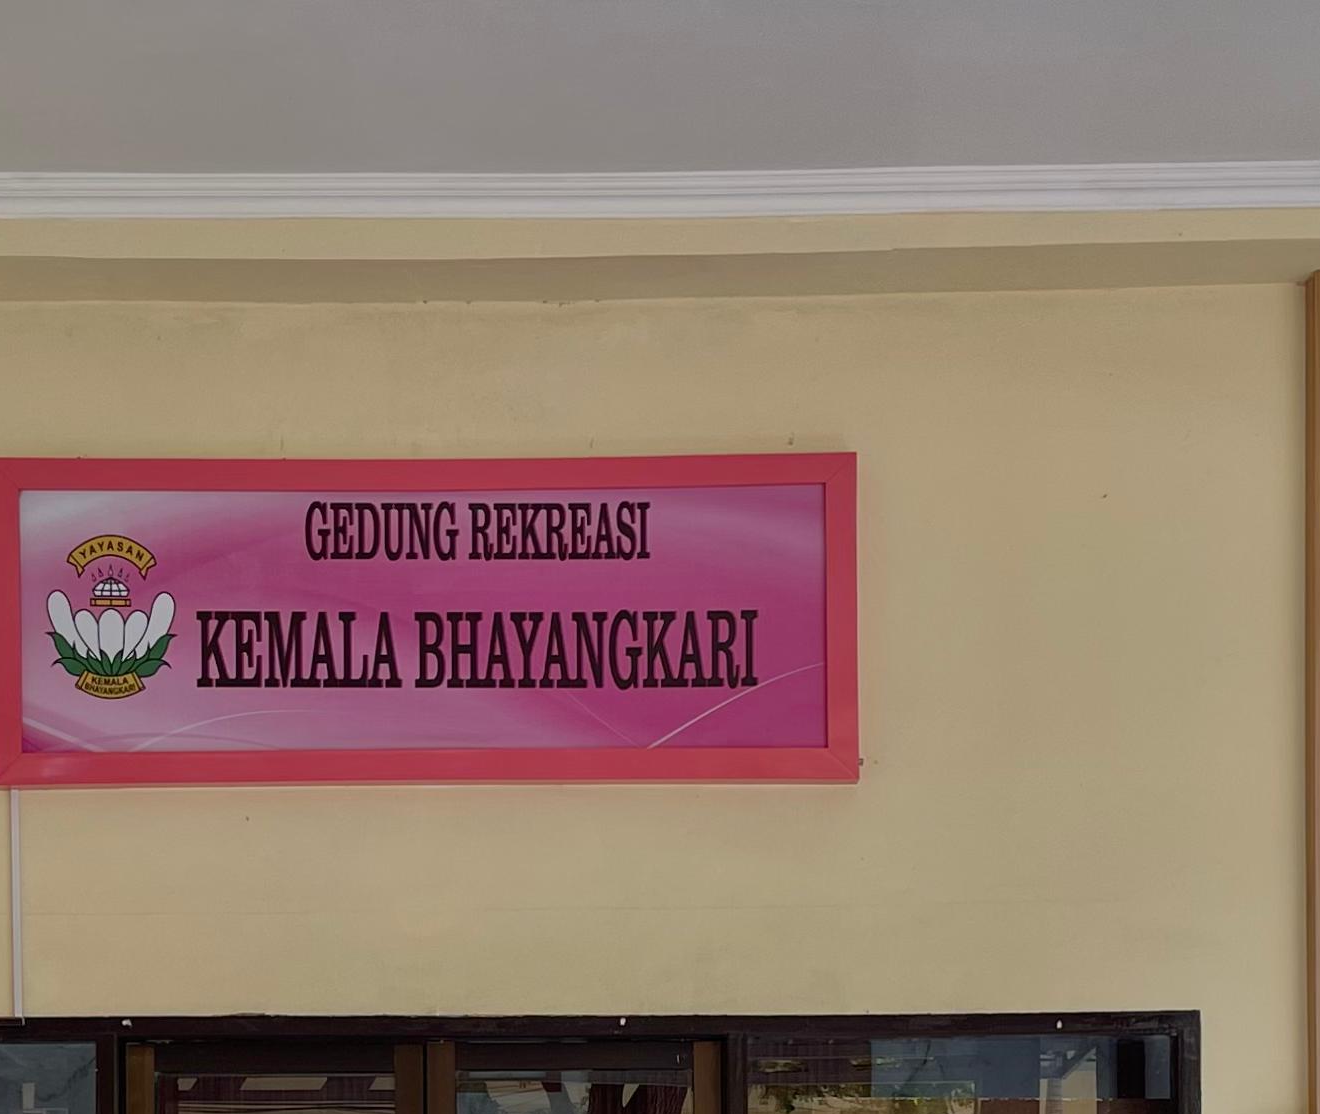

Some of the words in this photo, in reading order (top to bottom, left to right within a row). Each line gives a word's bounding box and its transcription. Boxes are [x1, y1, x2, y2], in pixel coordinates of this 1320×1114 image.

[304, 501, 459, 561] GEDUNG
[467, 500, 652, 560] REKREASI
[78, 542, 145, 562] YAYASAN
[195, 611, 402, 690] KEMALA
[413, 608, 760, 691] BHAYANGKARI
[84, 683, 137, 696] BHAYANGKARI
[90, 677, 129, 686] KEMALA
